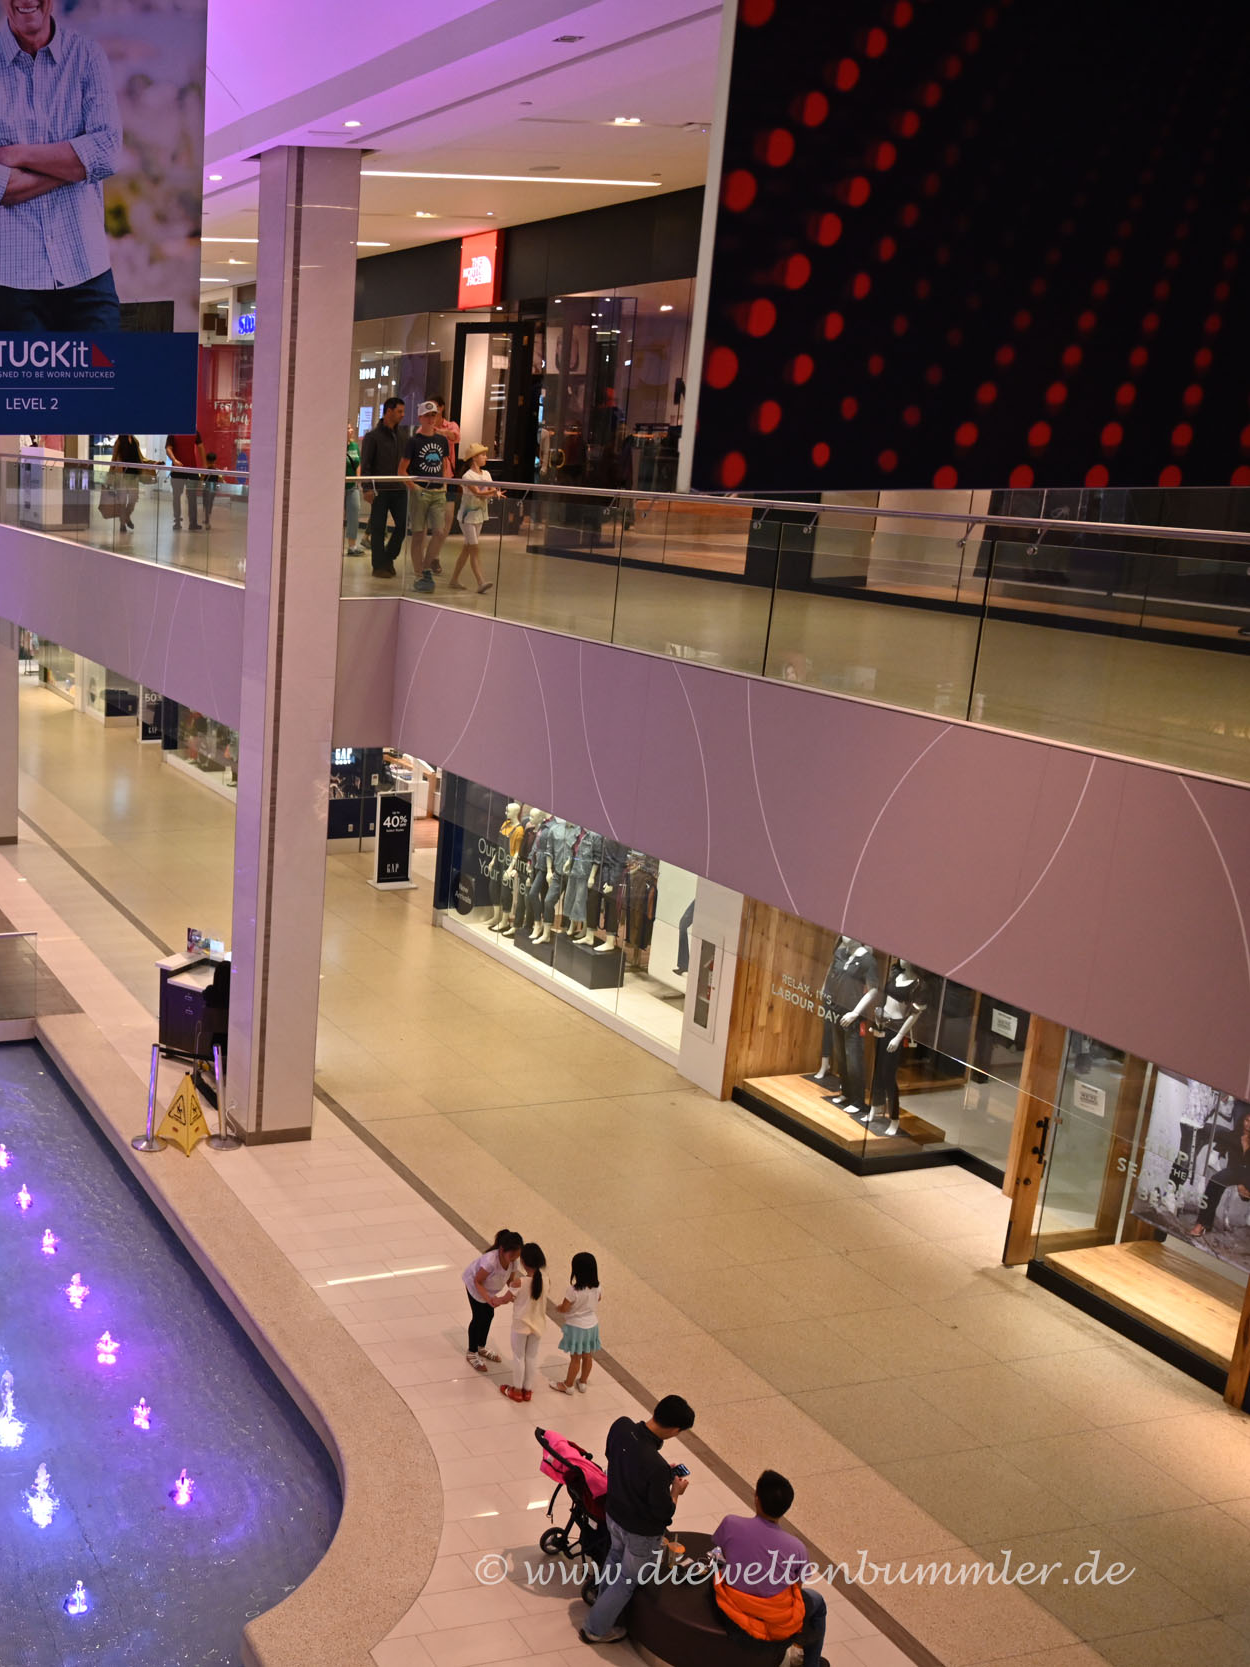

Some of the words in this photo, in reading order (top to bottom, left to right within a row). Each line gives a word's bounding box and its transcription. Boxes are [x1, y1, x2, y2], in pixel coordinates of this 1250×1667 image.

[21, 371, 33, 379] TO
[34, 371, 45, 379] BE
[46, 371, 71, 379] WORN
[73, 371, 116, 379] UNTUCKED
[6, 398, 46, 410] LEVEL
[51, 398, 59, 410] 2
[382, 815, 408, 828] 40%
[478, 838, 496, 857] Our
[497, 847, 529, 873] Deim
[781, 974, 813, 998] RELAX,
[771, 983, 815, 1013] LABOUR
[817, 1005, 840, 1024] DAY
